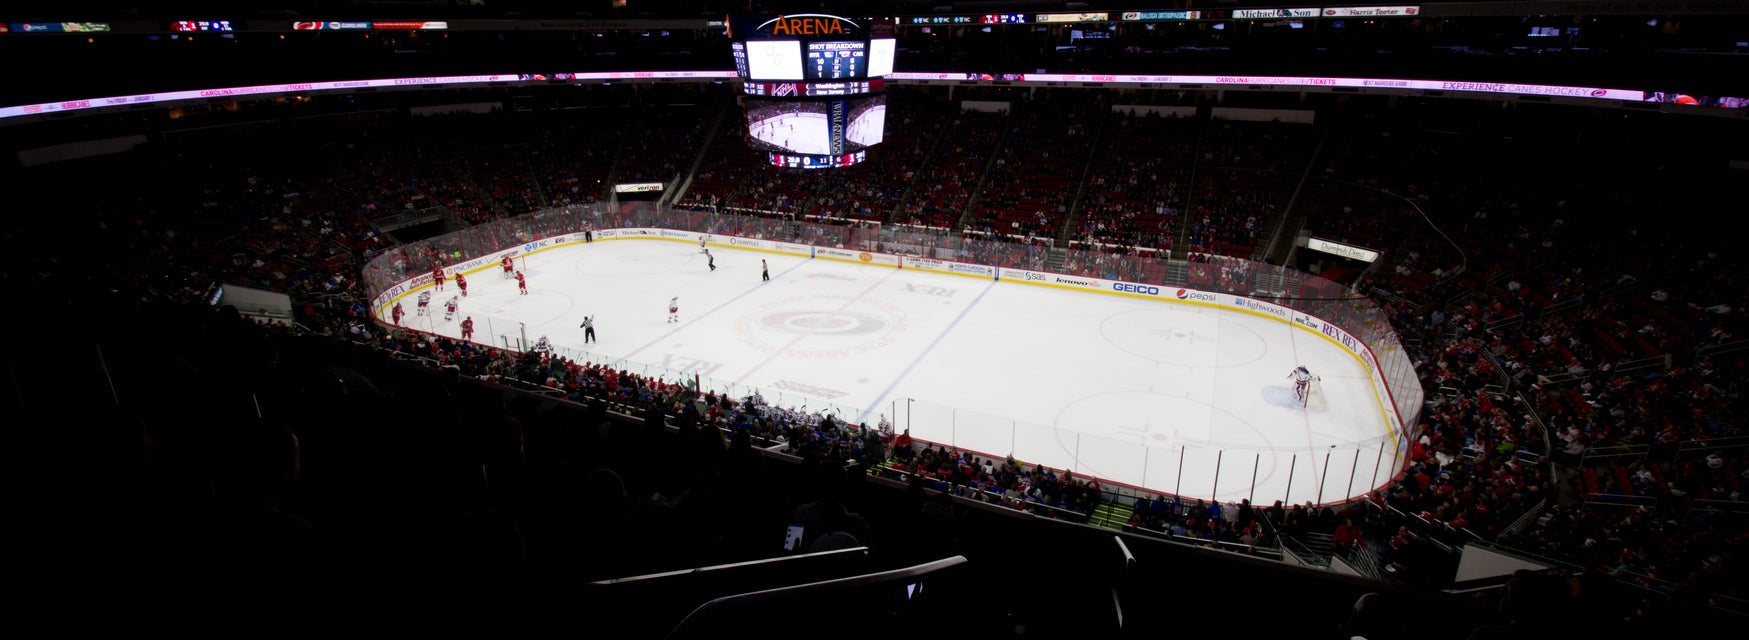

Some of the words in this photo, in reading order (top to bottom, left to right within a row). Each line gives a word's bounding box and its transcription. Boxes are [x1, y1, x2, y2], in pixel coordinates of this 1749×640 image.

[1239, 10, 1275, 18] Michael
[1293, 9, 1311, 17] Son
[773, 15, 843, 35] ARENA
[1216, 76, 1337, 86] CAROLINAHURRICANES.COM/TICKETS
[1442, 81, 1505, 92] EXPERIENCE
[1507, 84, 1542, 94] CANES
[1544, 86, 1589, 97] HOCKEY
[60, 100, 91, 110] HURRICANES
[833, 126, 842, 154] NEWS
[803, 156, 811, 165] 0
[539, 240, 548, 248] NC
[736, 239, 760, 247] QUINTILES
[1031, 273, 1046, 281] sas
[1056, 277, 1088, 286] lenovo
[1113, 282, 1159, 296] GEICO
[1189, 291, 1216, 302] pepsi
[1242, 299, 1286, 317] Highwoods
[1295, 317, 1318, 329] NHL.COM
[1322, 323, 1341, 341] REX
[1342, 333, 1359, 353] REX
